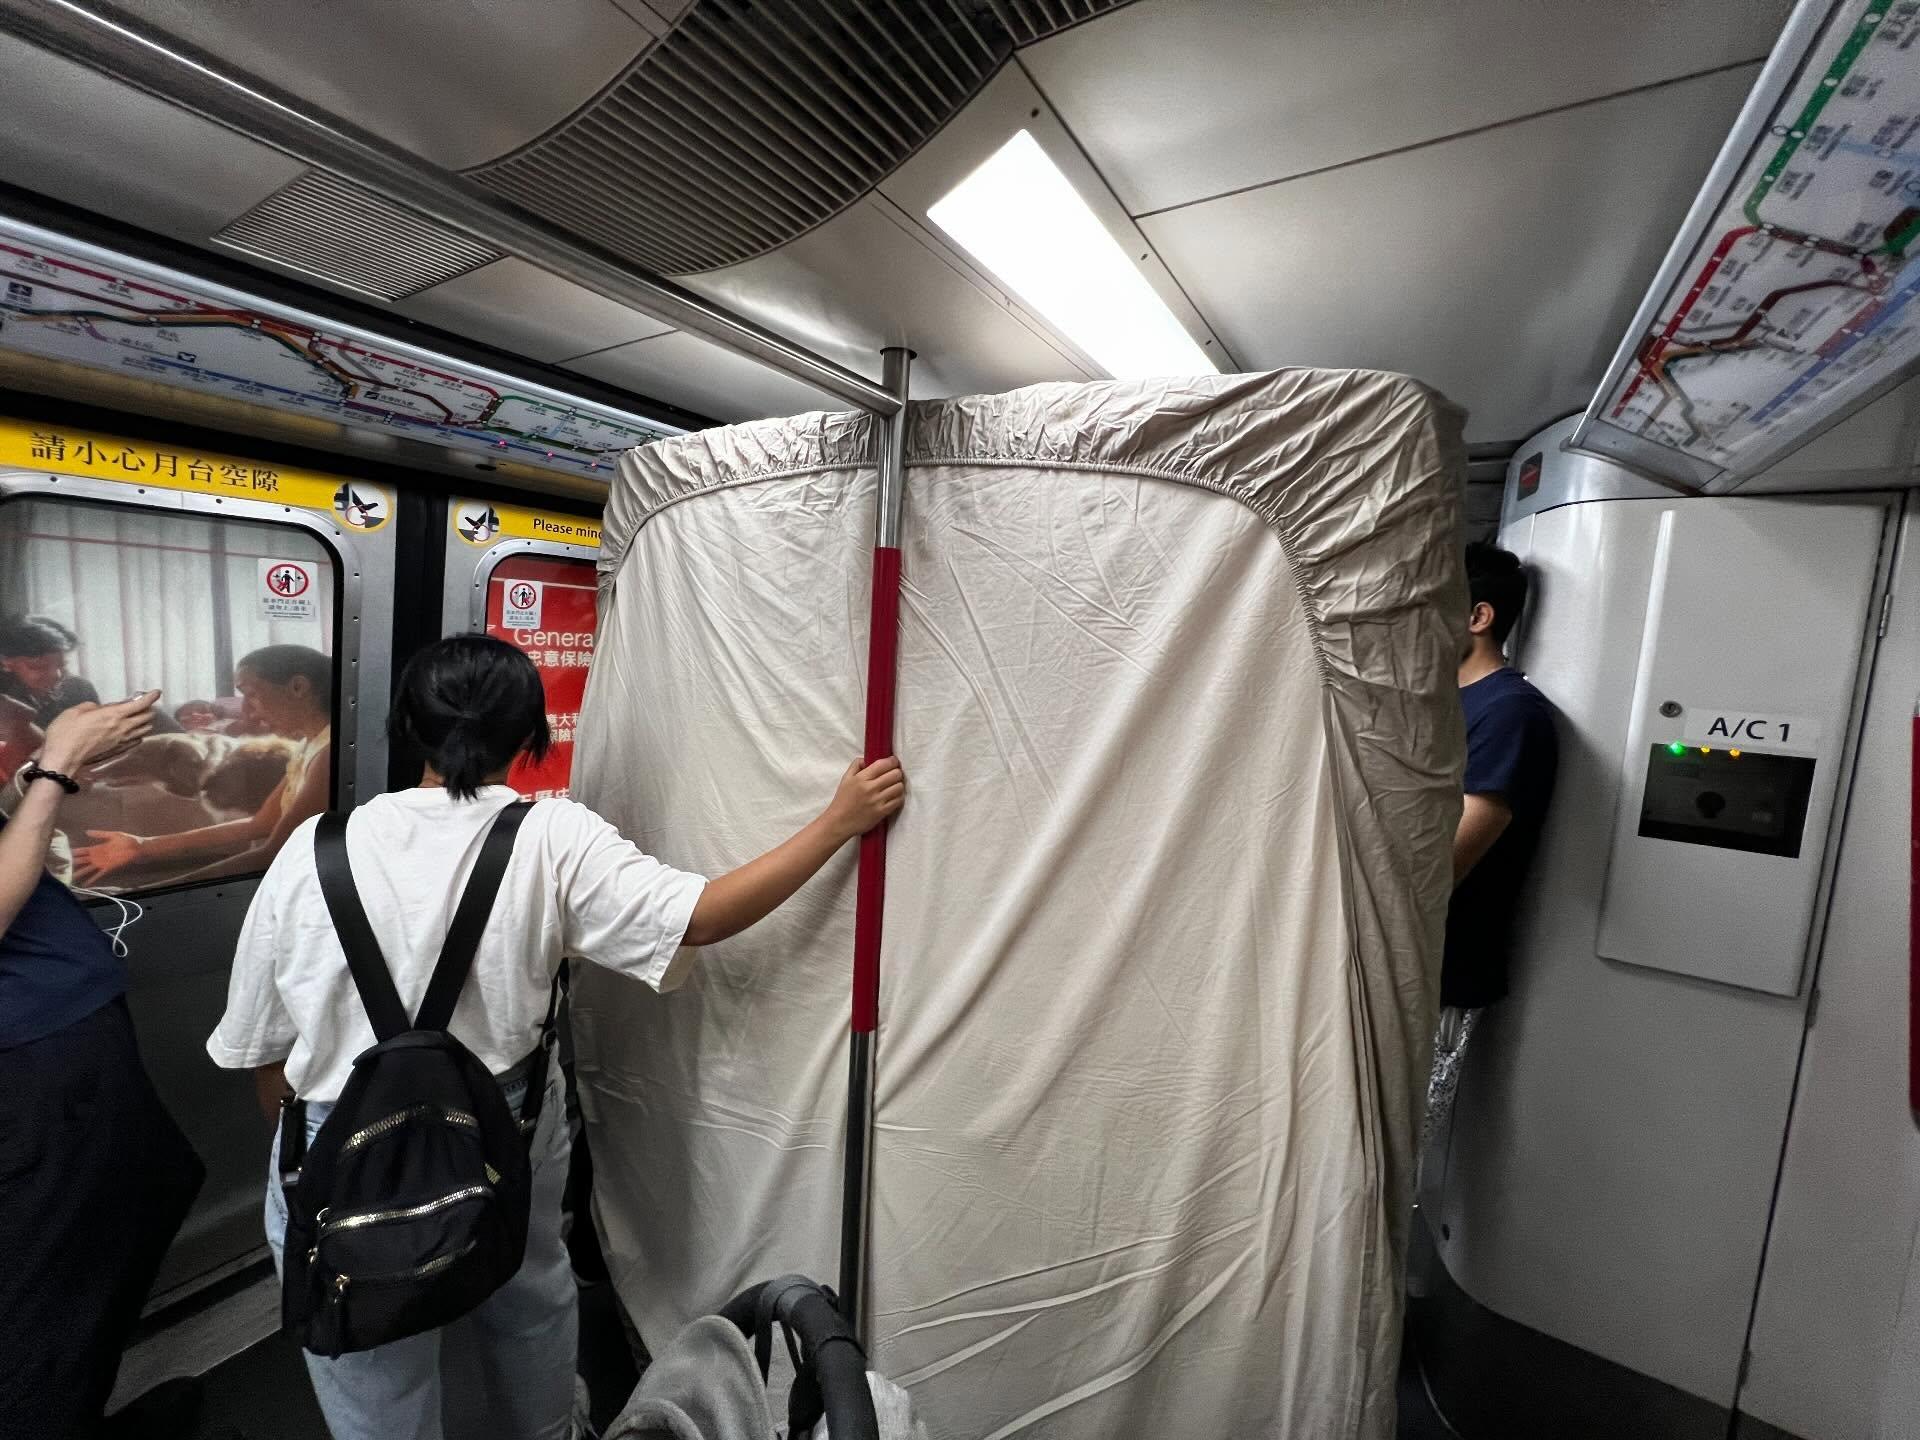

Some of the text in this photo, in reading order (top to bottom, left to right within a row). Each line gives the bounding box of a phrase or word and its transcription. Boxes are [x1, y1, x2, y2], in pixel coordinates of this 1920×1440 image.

[31, 432, 279, 492] 請小心月台空隙
[533, 518, 573, 534] Please
[1707, 717, 1790, 742] A/C 1
